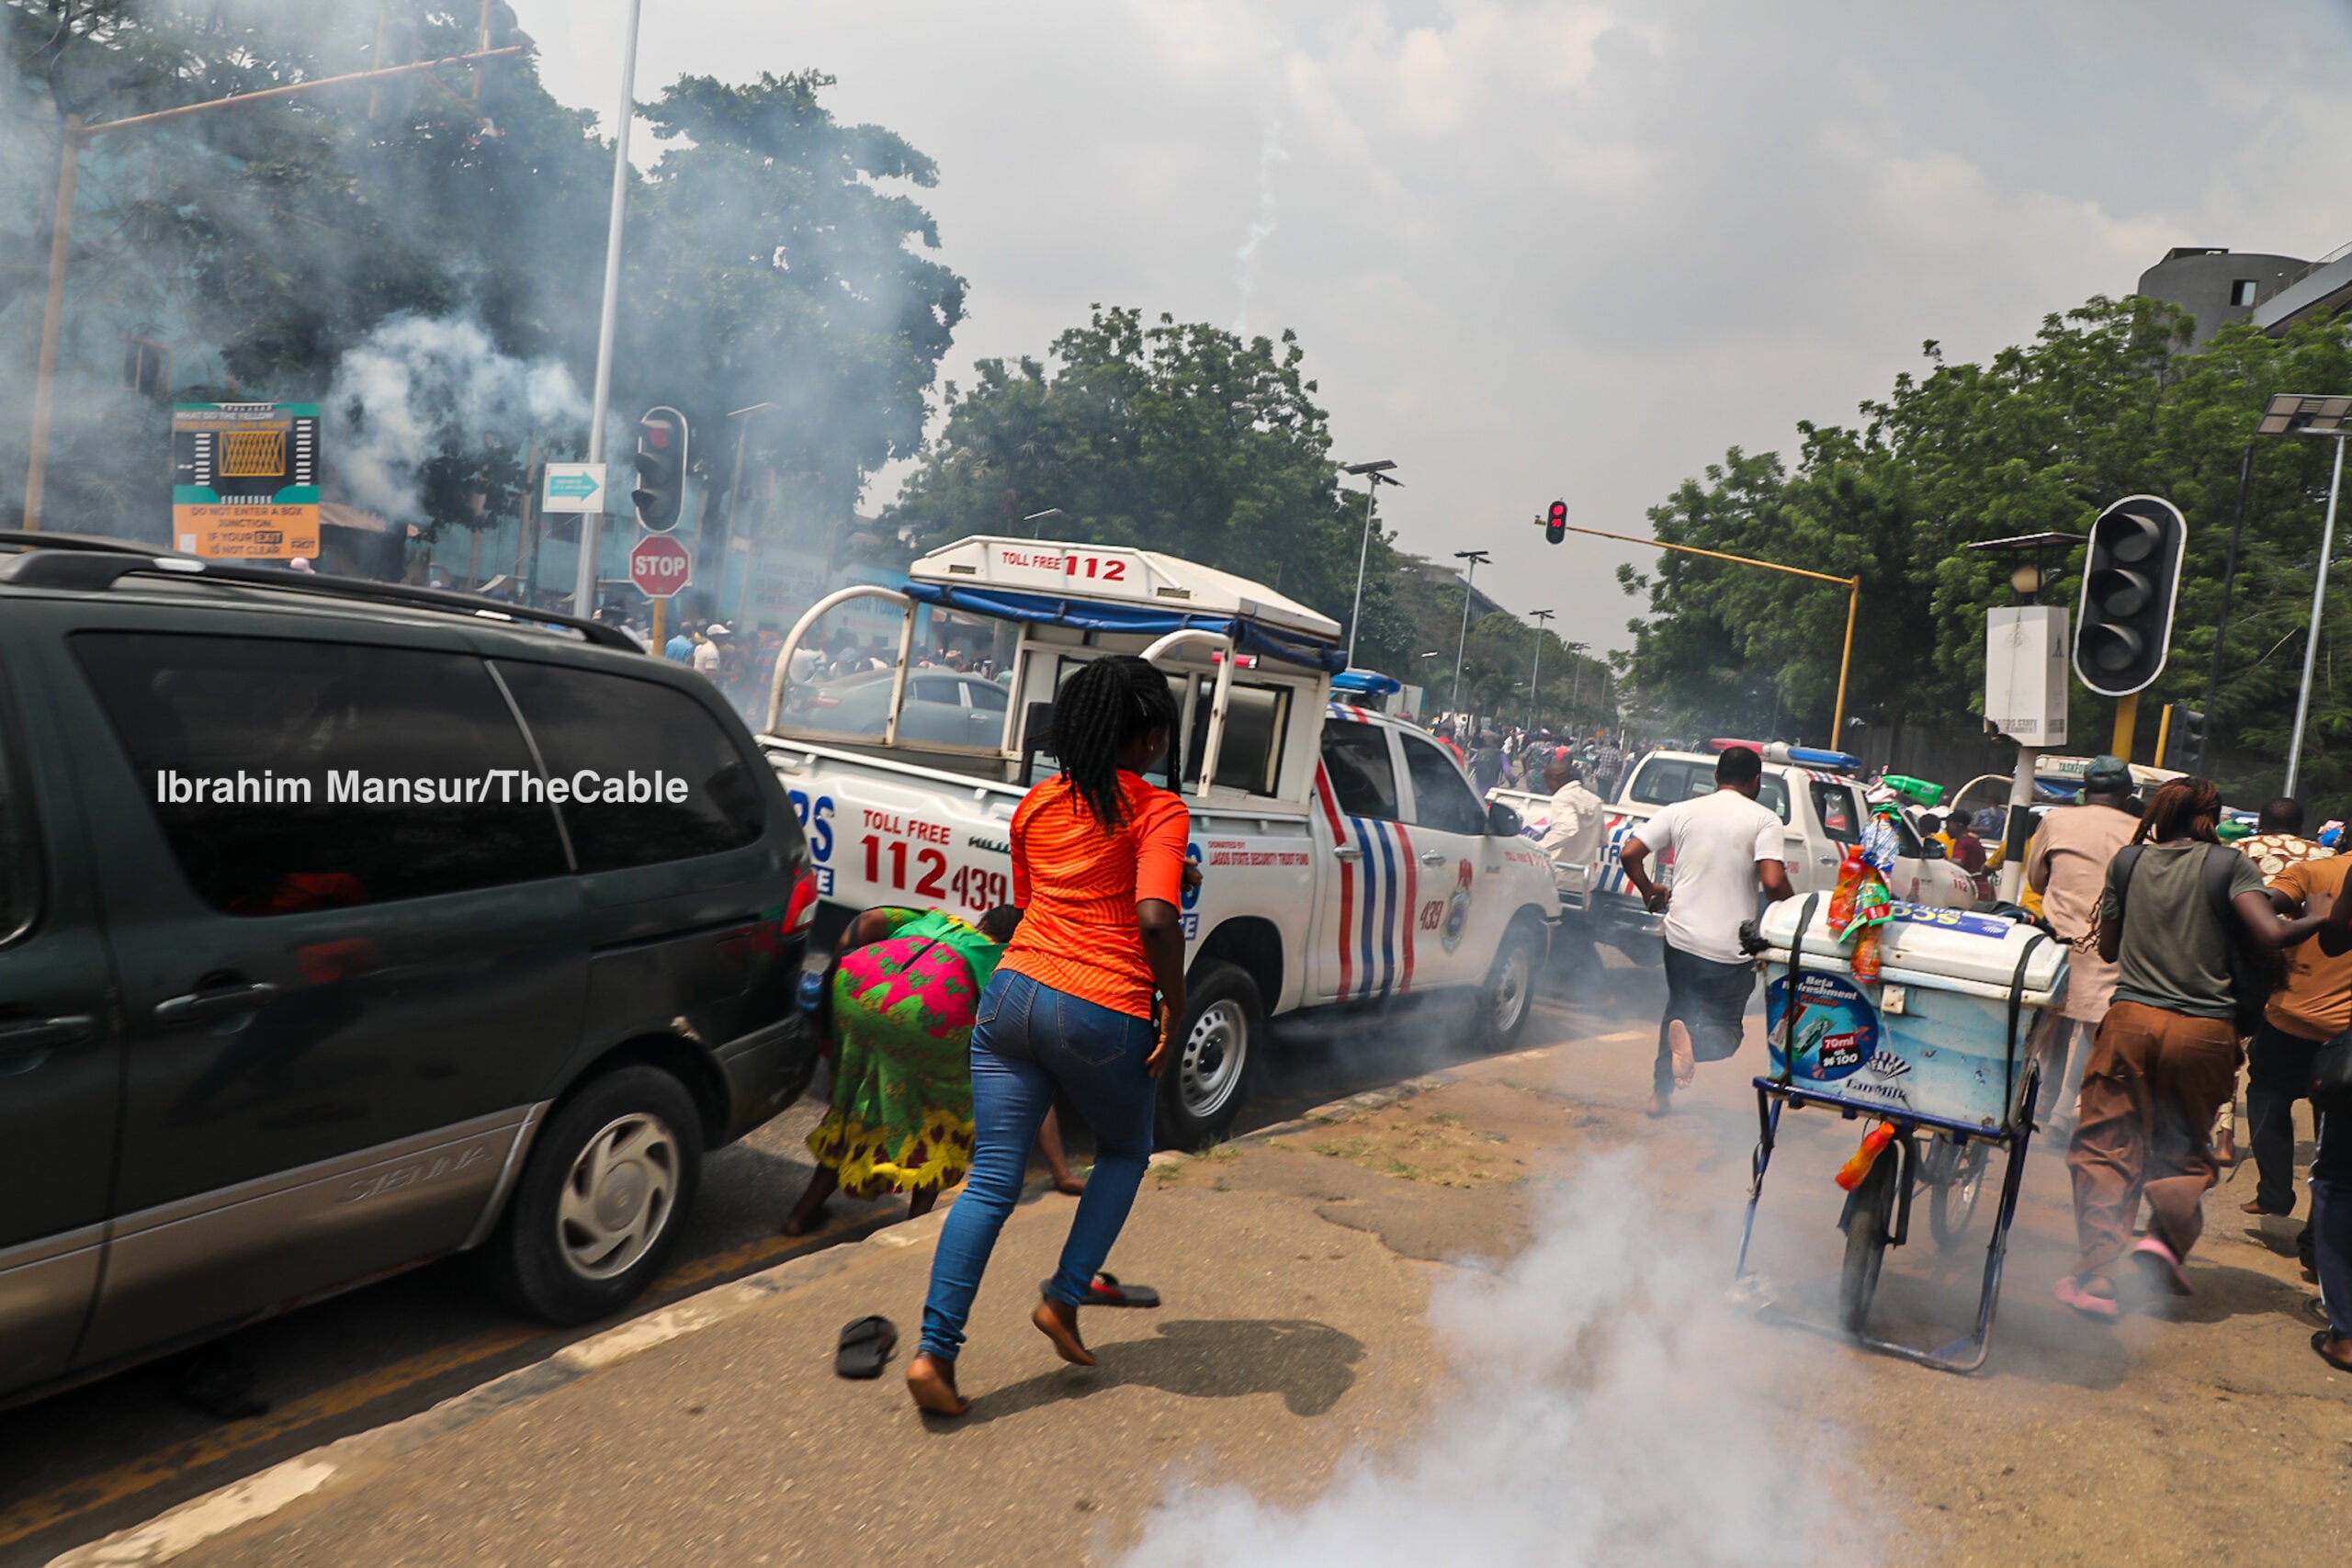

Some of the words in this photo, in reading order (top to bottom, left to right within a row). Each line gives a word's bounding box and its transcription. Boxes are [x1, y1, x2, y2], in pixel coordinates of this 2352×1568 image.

[239, 412, 275, 421] YELLOW
[191, 507, 207, 515] DO
[209, 507, 231, 515] NOT
[234, 507, 267, 515] ENTER
[271, 507, 278, 515] A
[281, 507, 303, 515] BOX
[221, 533, 253, 542] YOUR
[258, 534, 280, 542] EXIT
[222, 546, 243, 555] NOT
[246, 546, 280, 555] CLEAR
[635, 556, 685, 577] STOP
[1001, 552, 1029, 567] TOLL
[1032, 555, 1062, 570] FREE
[1064, 556, 1126, 581] 112
[863, 809, 902, 835] TOLL
[906, 819, 951, 845] FREE
[1209, 852, 1230, 865] LAGOS
[1231, 852, 1250, 866] STATE
[1250, 852, 1277, 866] SECURITY
[1278, 852, 1295, 866] TRUST
[860, 834, 947, 900] 112
[951, 864, 1008, 912] 439
[1953, 878, 1968, 893] 112
[1419, 900, 1444, 931] 439
[1805, 976, 1834, 989] Beta
[1781, 980, 1858, 1001] Rfreshment
[1800, 993, 1839, 1008] Promo
[1824, 1035, 1854, 1049] 70ml
[1834, 1048, 1846, 1056] at
